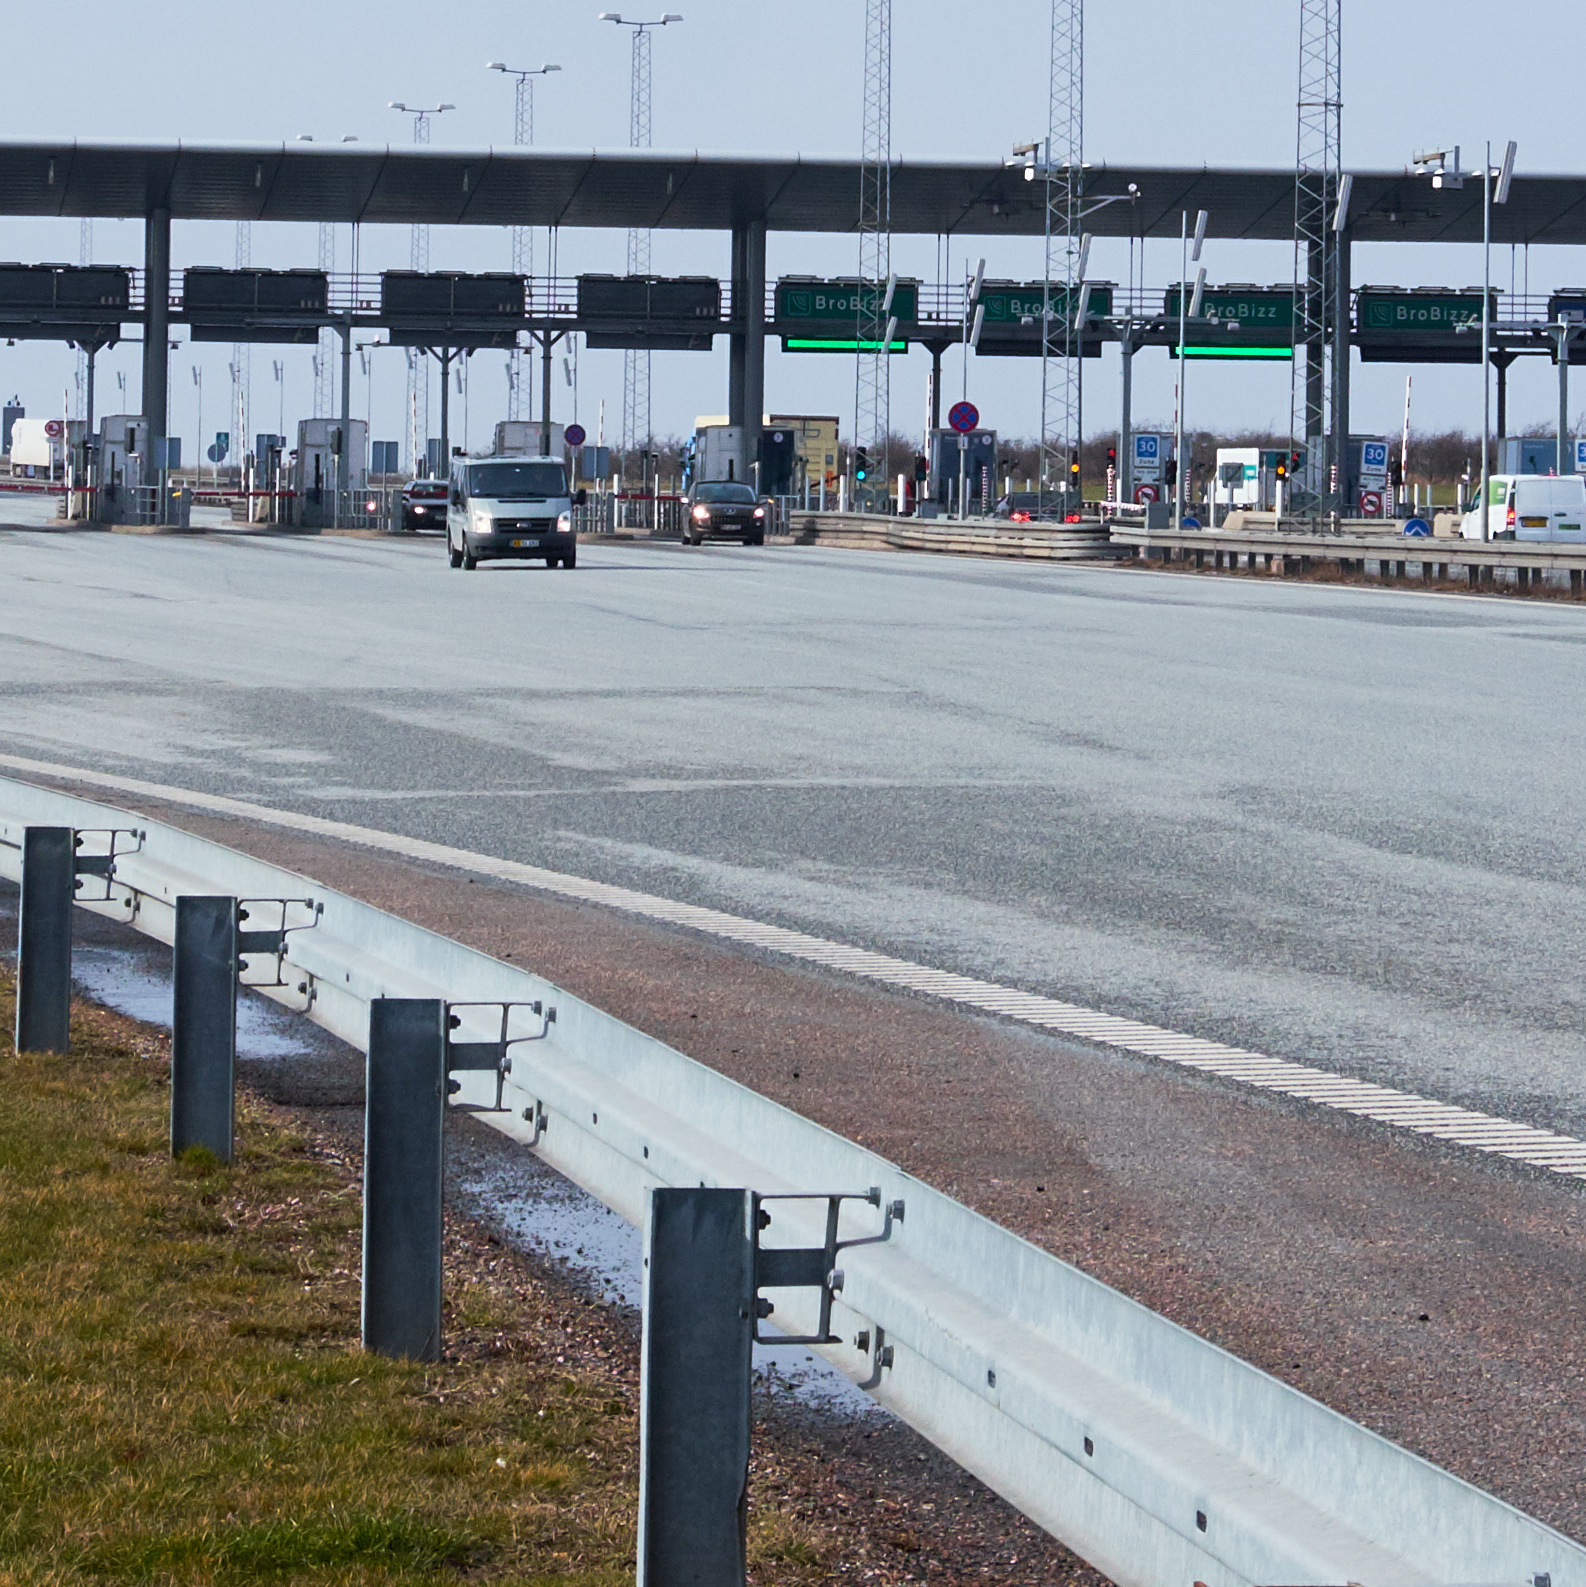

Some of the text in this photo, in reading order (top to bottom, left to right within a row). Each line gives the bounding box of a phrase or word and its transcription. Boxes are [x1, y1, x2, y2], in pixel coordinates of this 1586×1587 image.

[1396, 306, 1469, 321] BroBizz
[1138, 441, 1156, 452] 30
[1366, 447, 1384, 460] 30
